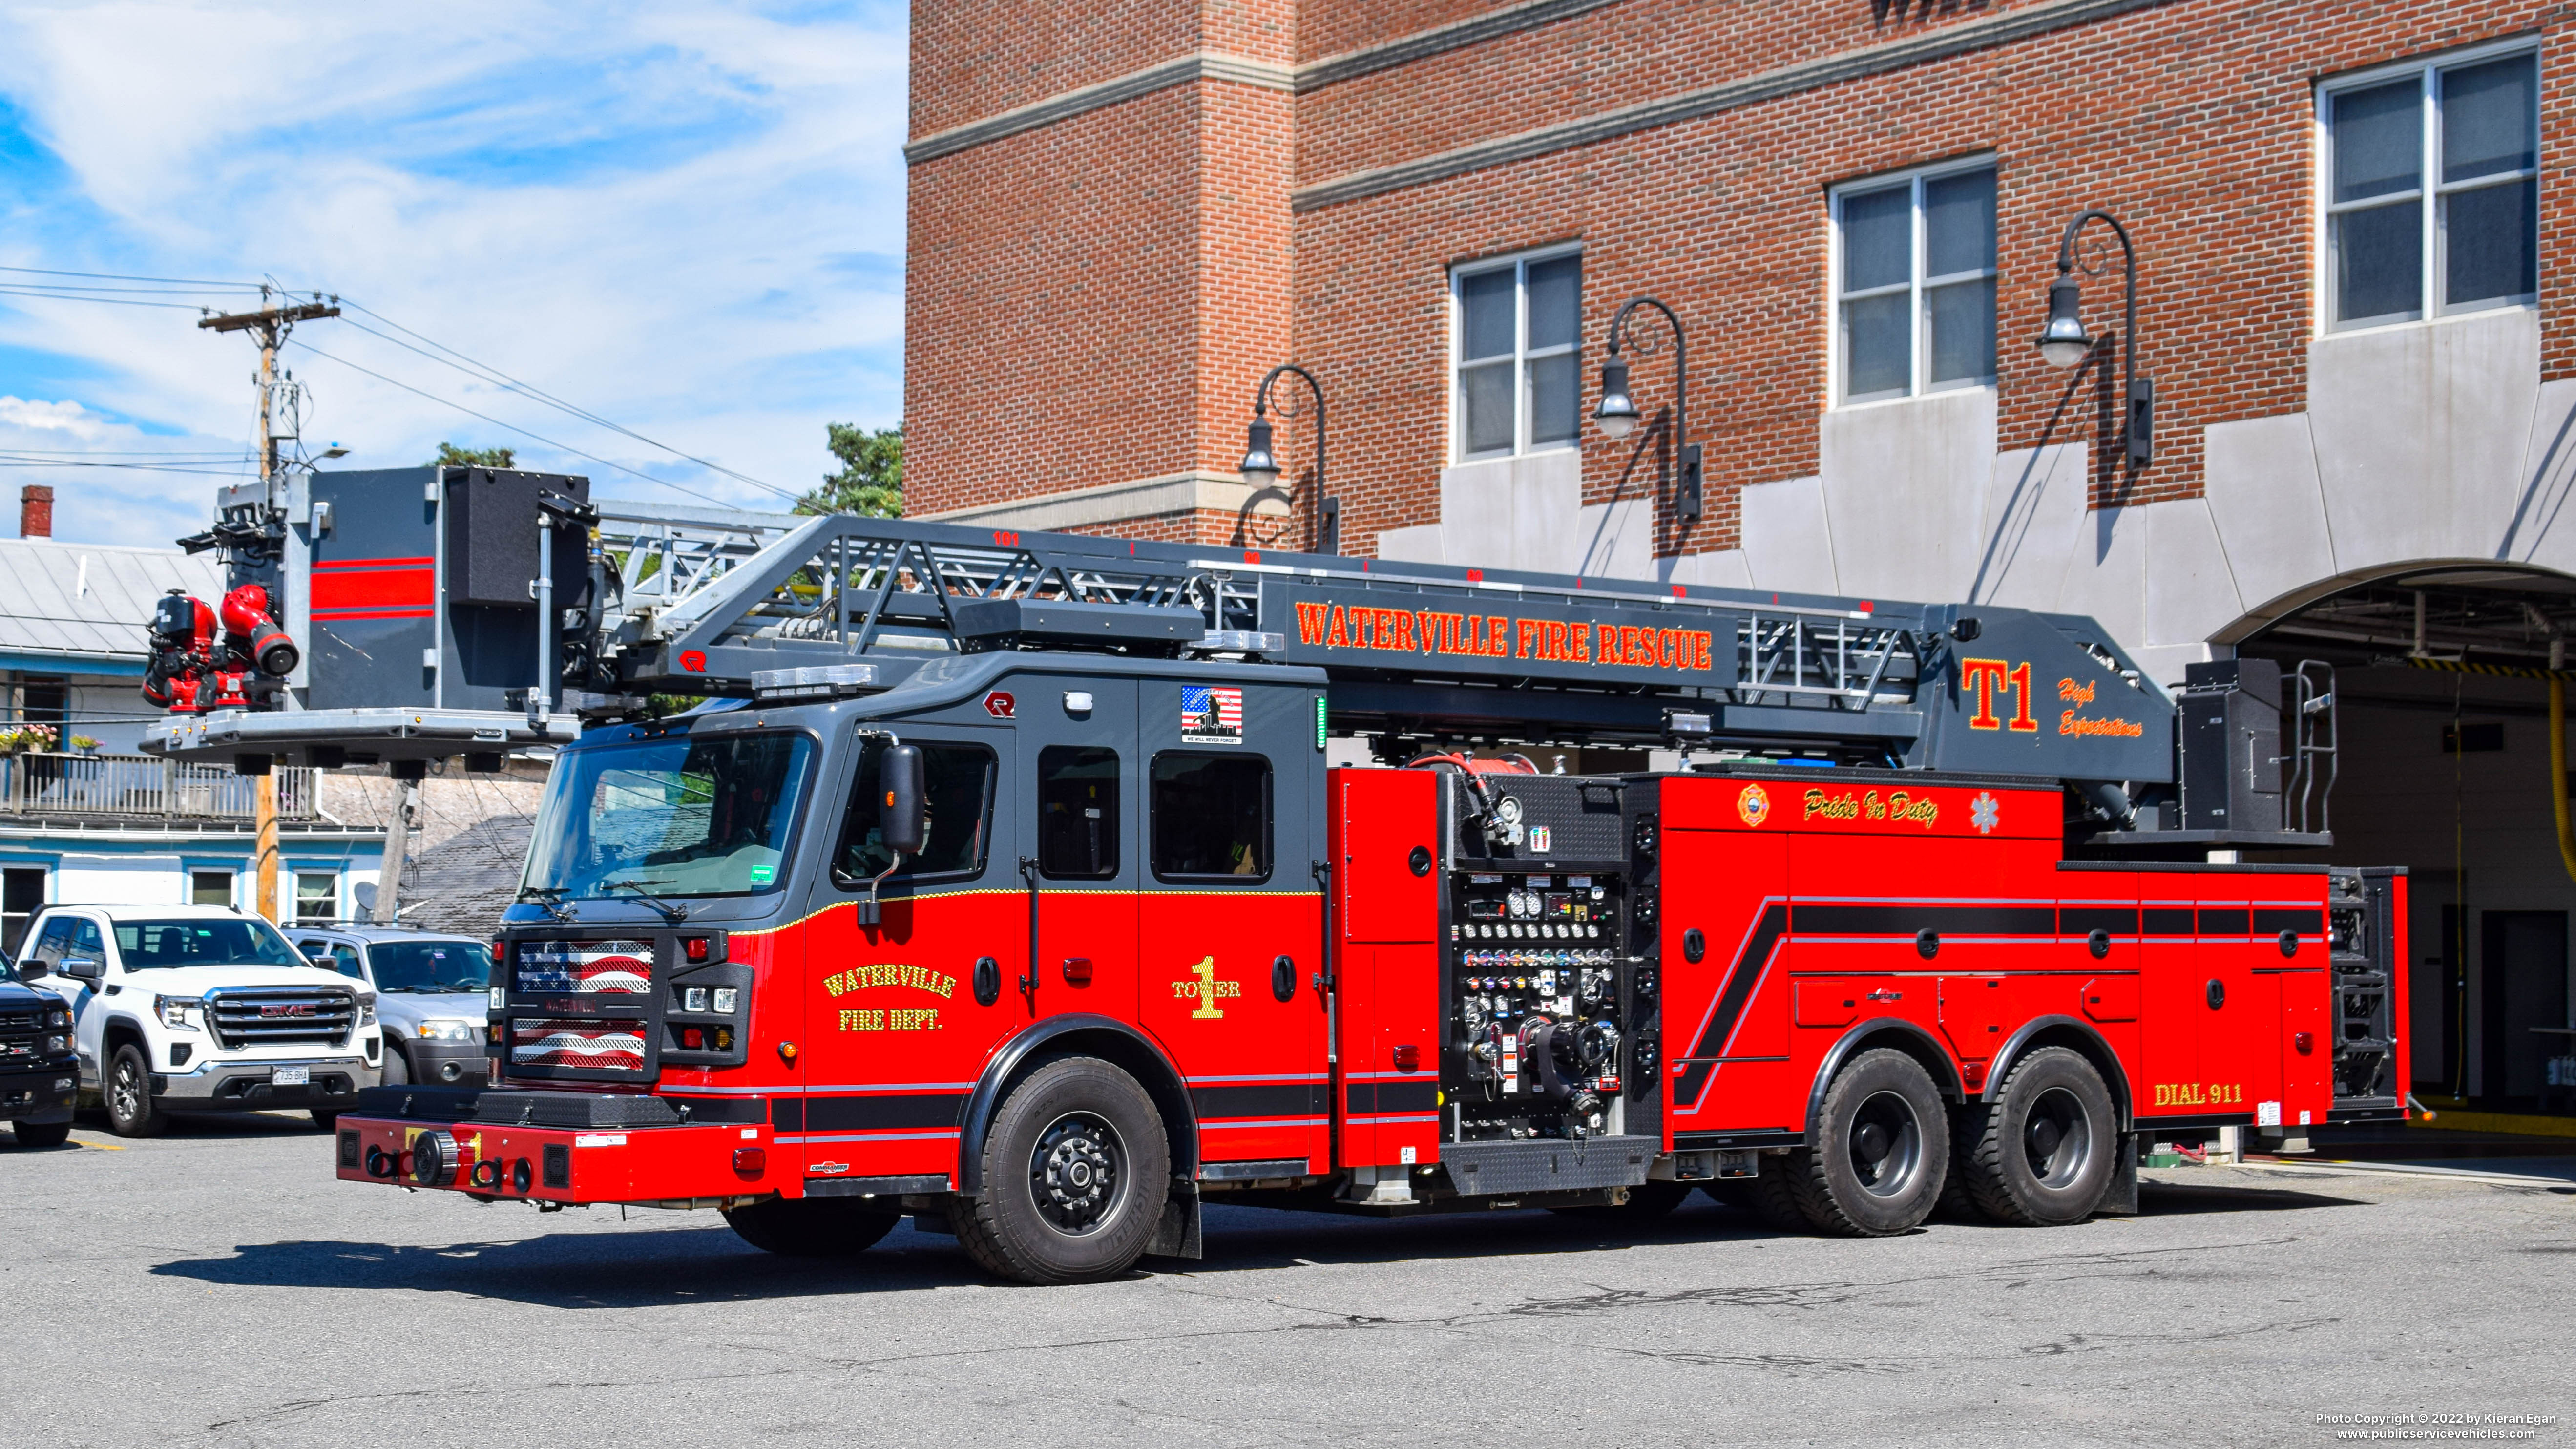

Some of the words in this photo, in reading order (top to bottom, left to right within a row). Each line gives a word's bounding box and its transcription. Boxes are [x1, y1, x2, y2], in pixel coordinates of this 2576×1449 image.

[993, 531, 1019, 547] 101
[1243, 551, 1261, 565] 90
[1672, 585, 1687, 598] 70
[1295, 602, 1508, 657] WATERVILLE
[1515, 618, 1590, 663] FIRE
[1597, 624, 1712, 671] RESCUE
[1191, 689, 1216, 707] SEPTEMBER
[1962, 657, 2038, 732] T1
[2057, 677, 2095, 708] High
[2059, 710, 2142, 739] Expectations
[1804, 788, 1858, 820] Pride
[1864, 790, 1885, 820] In
[1889, 791, 1937, 828] Duty
[823, 964, 957, 999] WATERVILLE
[1172, 981, 1241, 998] TOWER
[1192, 955, 1223, 1019] 1
[261, 1004, 316, 1016] GMC
[839, 1008, 884, 1031] FIRE
[889, 1008, 943, 1031] DEPT.
[2154, 1083, 2206, 1106] DIAL
[2209, 1083, 2242, 1104] 911
[1096, 1166, 1153, 1254] MICHELIN
